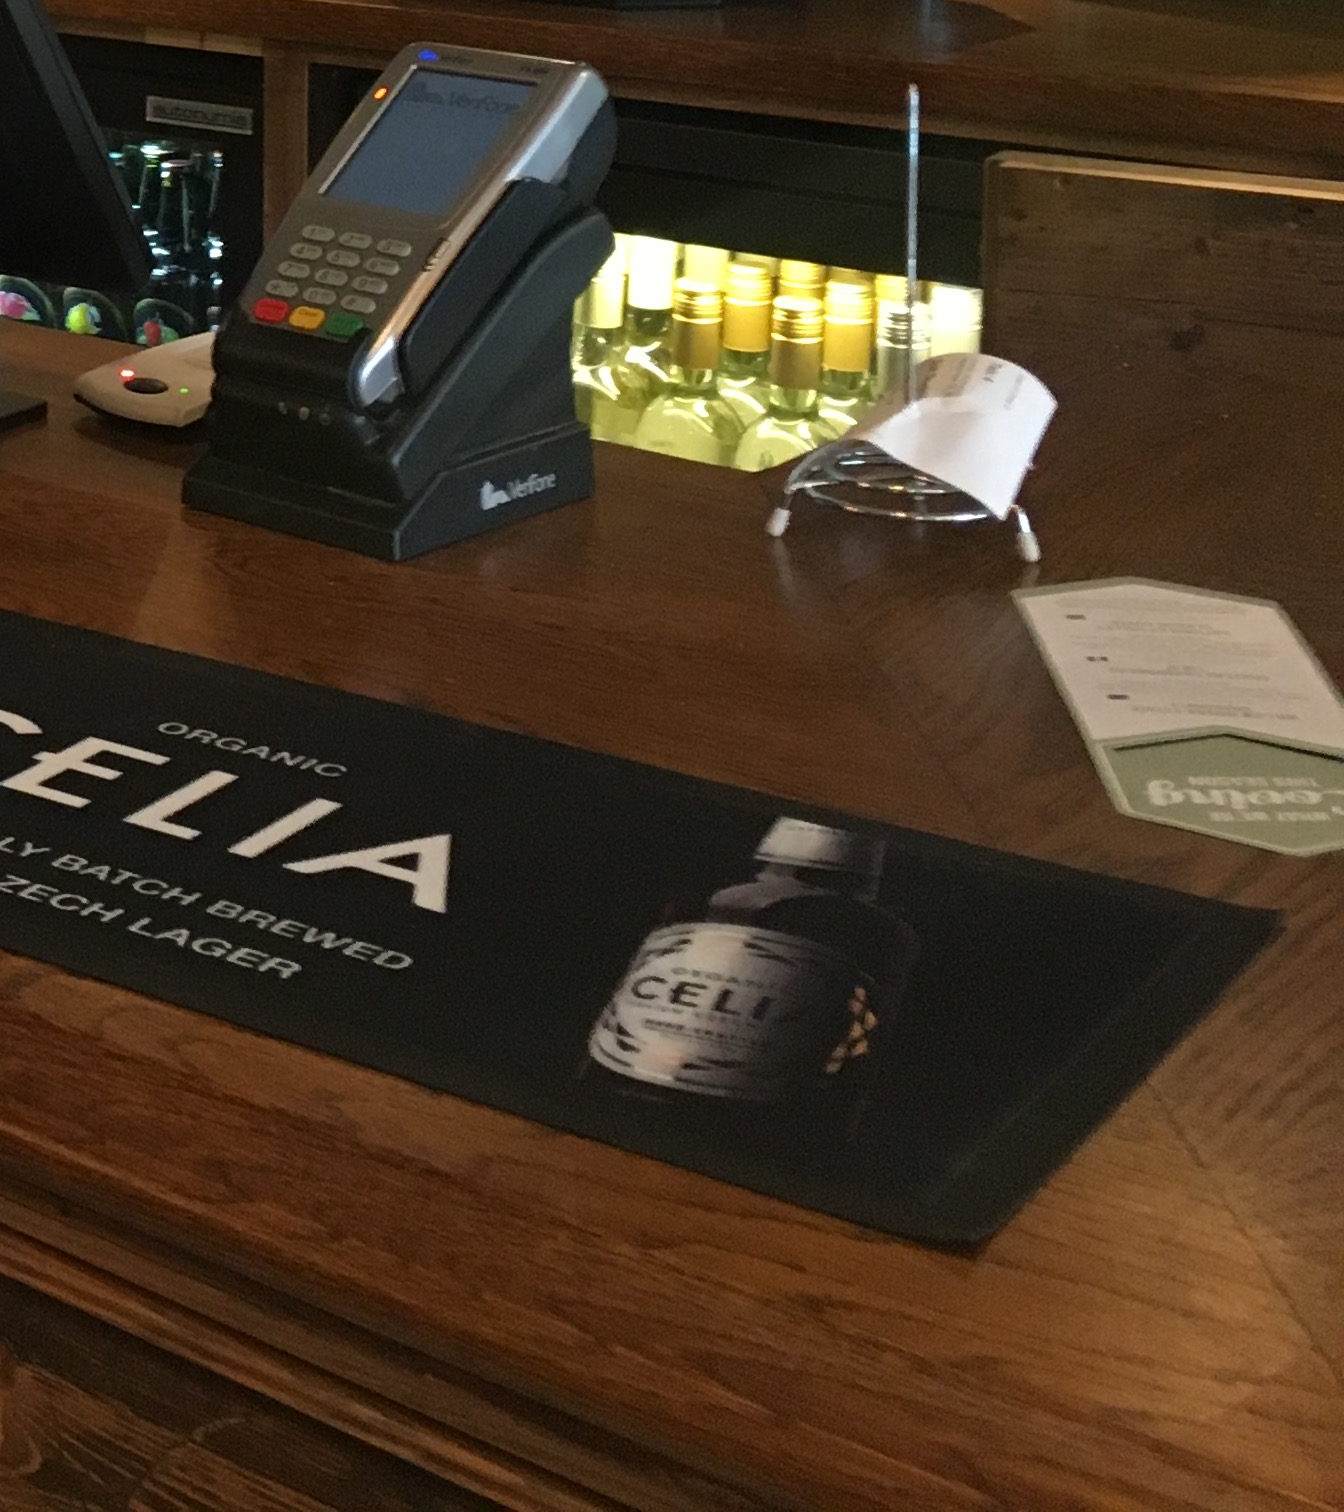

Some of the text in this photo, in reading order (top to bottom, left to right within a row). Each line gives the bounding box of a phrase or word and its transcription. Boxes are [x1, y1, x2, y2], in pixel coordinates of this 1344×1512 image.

[157, 721, 348, 779] ORGANIC
[50, 852, 202, 906] BATCH
[205, 898, 414, 971] BREWED
[127, 916, 303, 979] LAGER
[629, 974, 777, 1022] CELI
